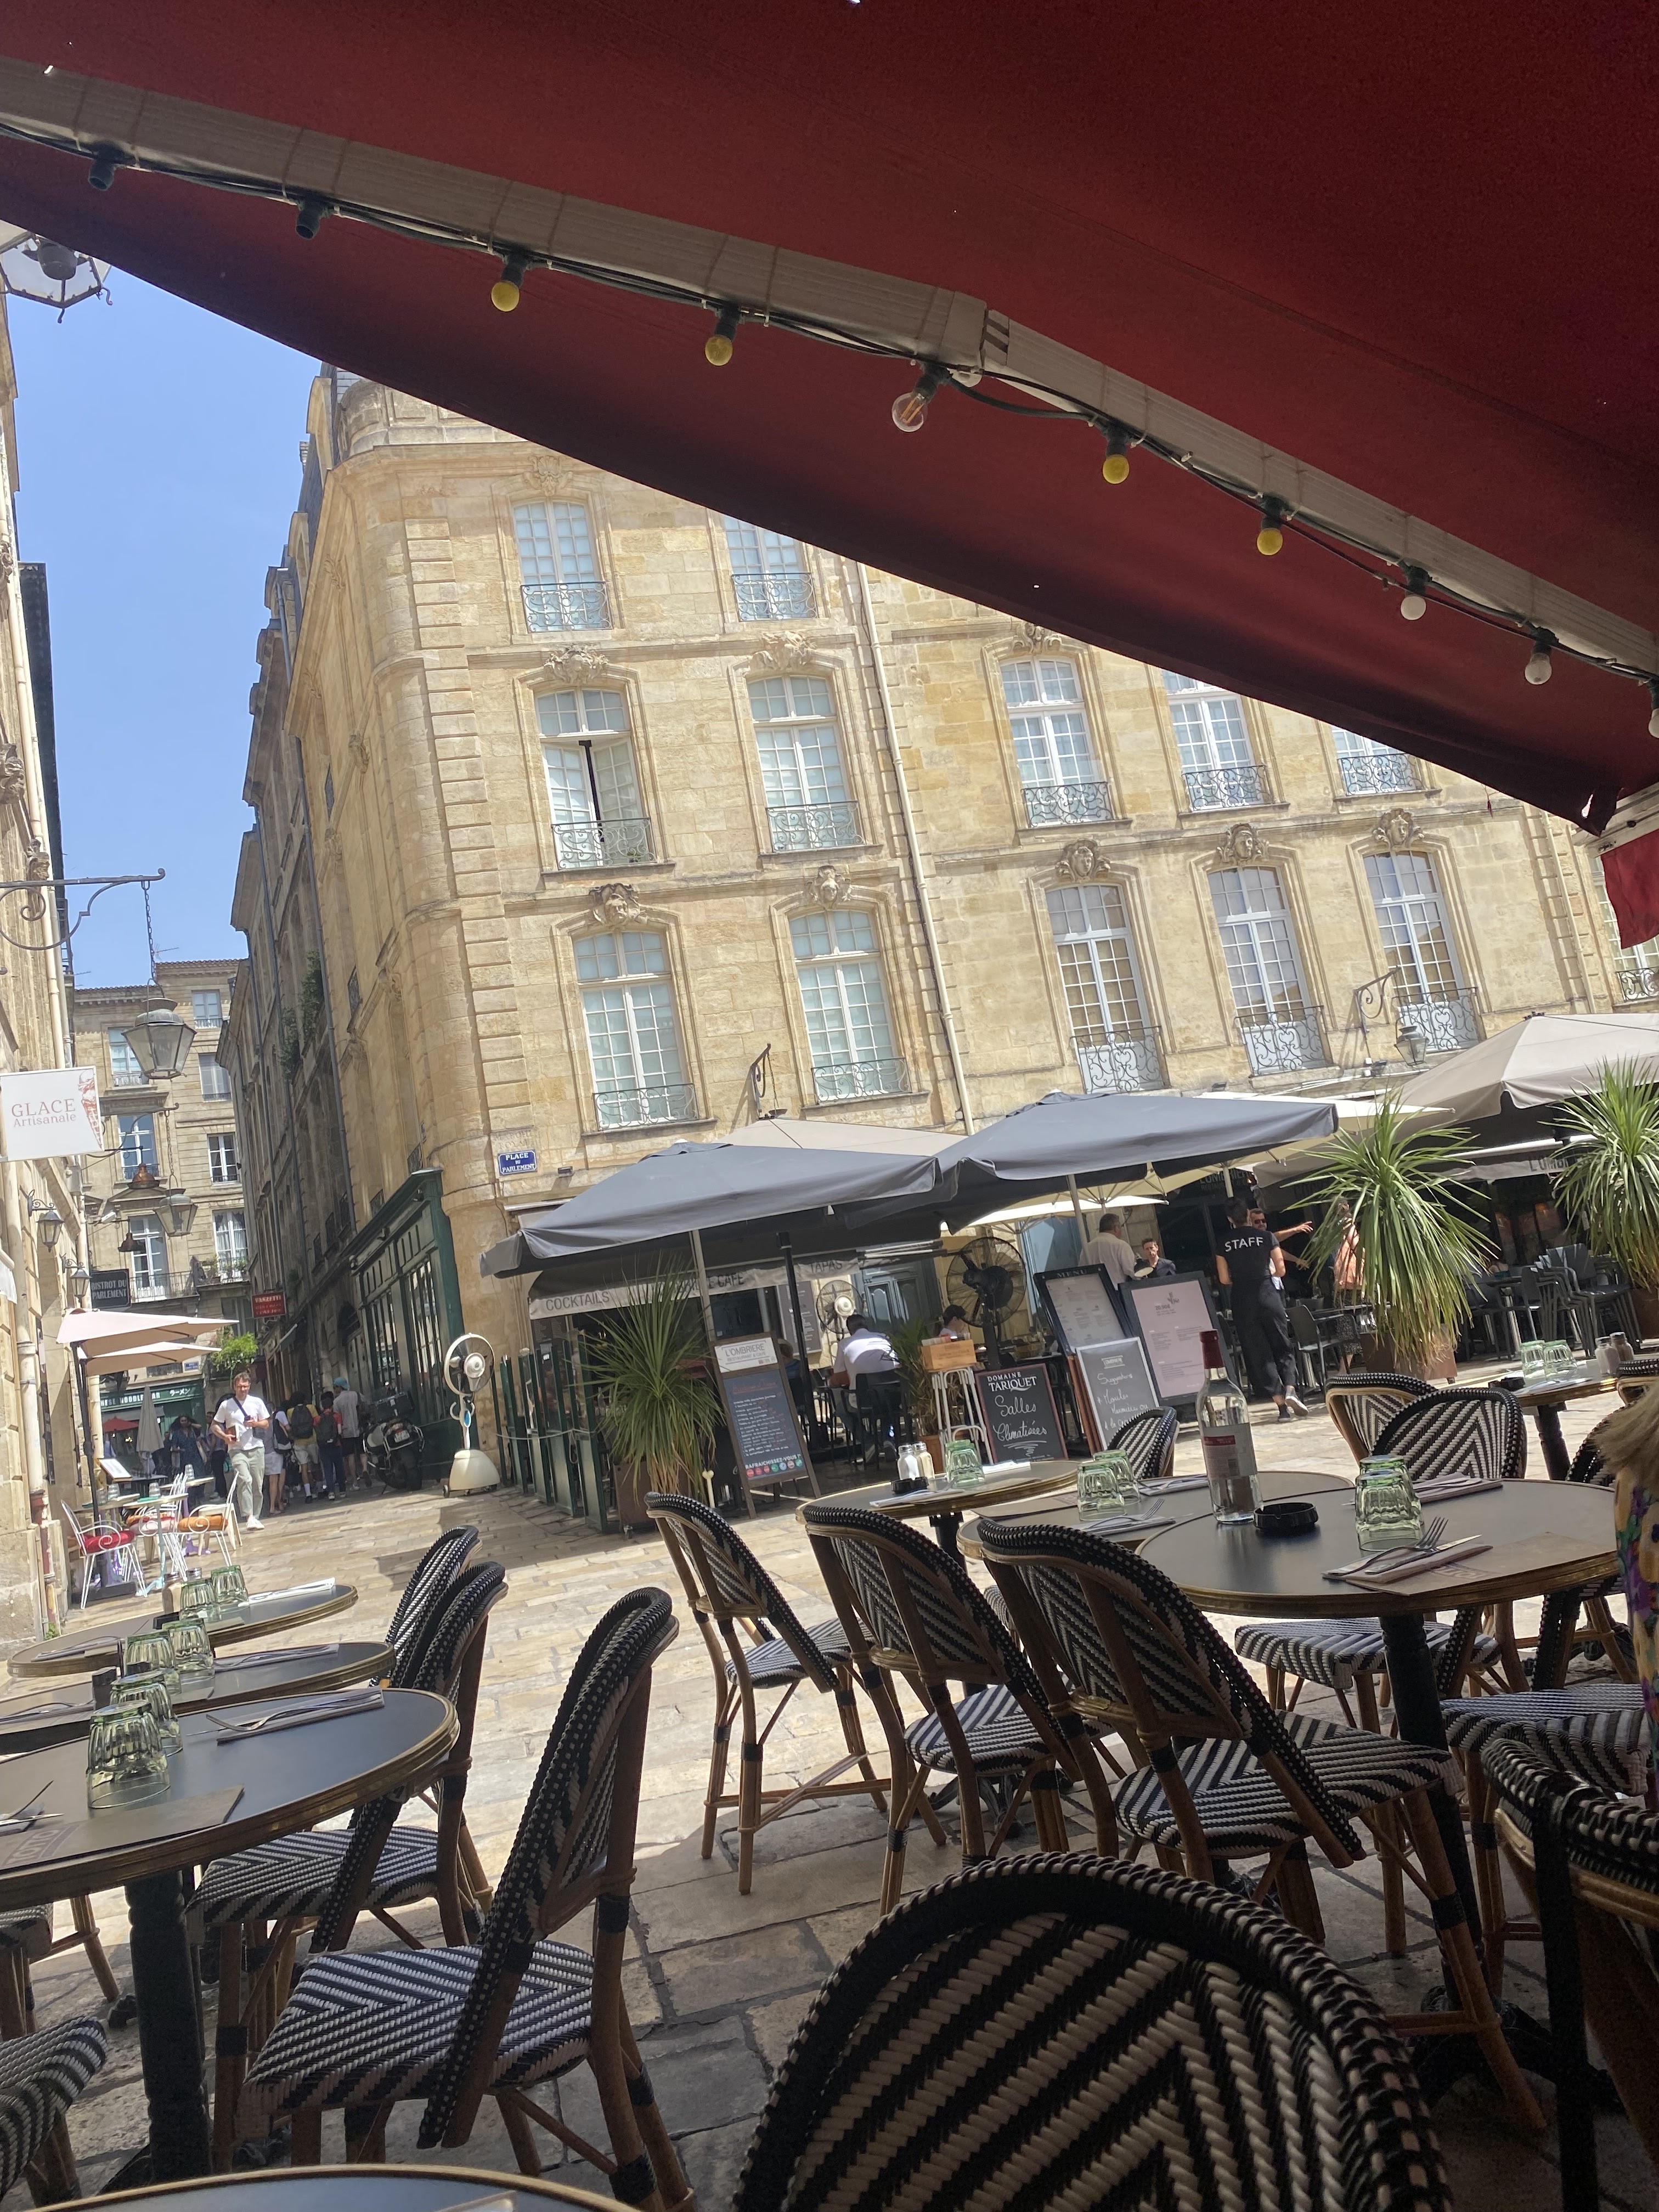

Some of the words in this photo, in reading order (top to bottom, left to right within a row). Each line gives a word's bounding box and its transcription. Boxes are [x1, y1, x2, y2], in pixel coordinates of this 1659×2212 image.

[12, 1098, 75, 1117] GLACE
[14, 1113, 76, 1128] Artisanale
[502, 1164, 534, 1172] PARLEMENT
[1224, 1237, 1263, 1252] STAFF
[1057, 1269, 1087, 1278] MENU
[91, 1280, 116, 1290] BISTROT
[92, 1289, 127, 1300] PARLEMENT
[546, 1291, 610, 1312] COCKTAILS
[725, 1343, 765, 1357] L'OMBRIERE
[988, 1372, 1022, 1382] DOMAINE
[988, 1376, 1037, 1392] TARIQUET
[170, 1388, 190, 1397] ラーメン
[995, 1395, 1036, 1417] Salles
[992, 1420, 1048, 1442] Climatisées
